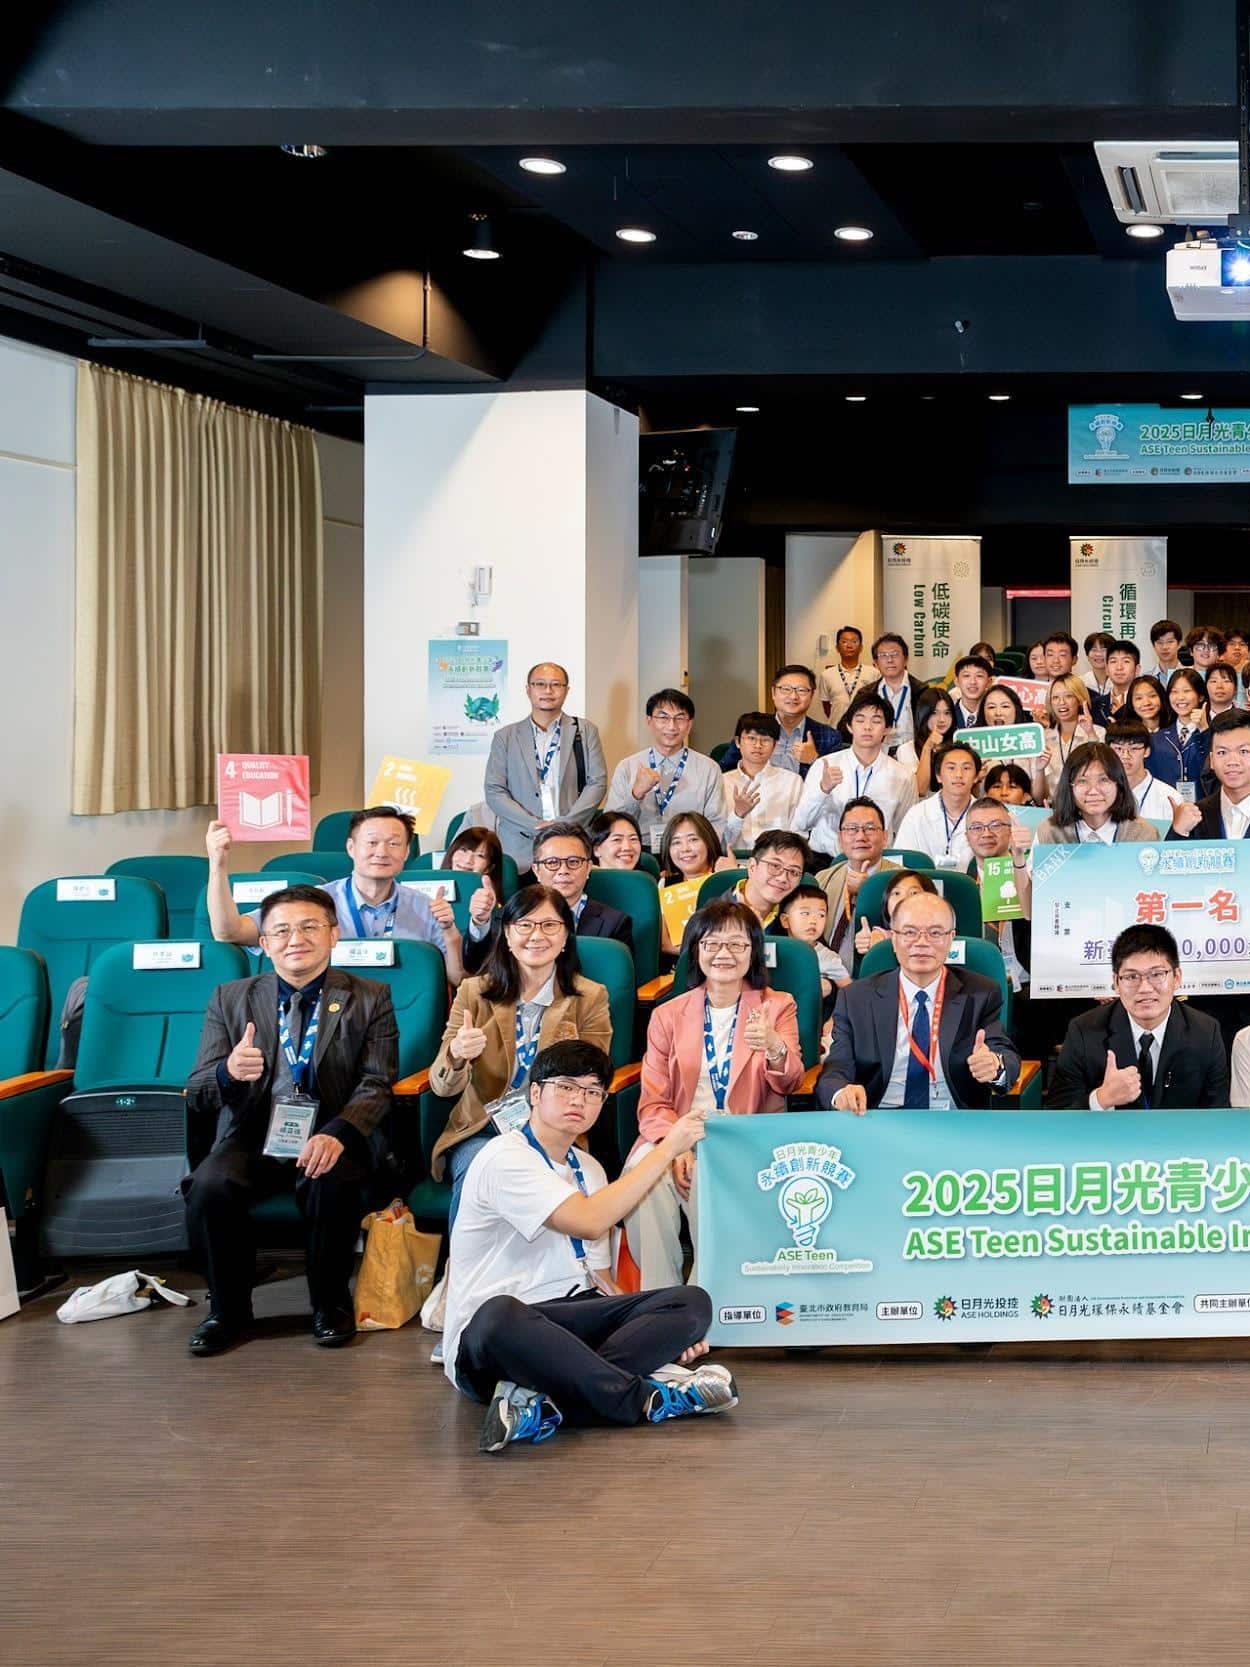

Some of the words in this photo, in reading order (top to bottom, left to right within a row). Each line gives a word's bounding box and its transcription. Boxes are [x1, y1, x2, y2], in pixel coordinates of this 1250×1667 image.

[1141, 444, 1161, 454] ASE
[1163, 444, 1187, 454] Teen
[1190, 443, 1250, 454] Sustainable
[913, 585, 926, 606] Low
[1119, 583, 1136, 639] 循環再
[931, 582, 950, 659] 低碳使命
[913, 611, 926, 657] Carbon
[225, 761, 236, 779] 4
[242, 771, 279, 780] EDUCATION
[988, 862, 1001, 876] 15
[1036, 845, 1071, 881] BANK
[1135, 890, 1238, 924] 第一名
[777, 1145, 838, 1160] 日月光青少年
[760, 1156, 850, 1188] 永續創新競賽
[906, 1230, 961, 1256] ASE
[969, 1229, 1039, 1254] Teen
[1047, 1222, 1223, 1253] Sustainable
[778, 1251, 802, 1261] ASE
[805, 1251, 834, 1261] Teen
[799, 1303, 868, 1314] 臺北市政府教育局
[881, 1306, 918, 1317] 主辦單位
[961, 1298, 1019, 1310] 日月光投控
[1059, 1301, 1184, 1317] 日月光環保永續基金會
[723, 1310, 761, 1321] 指導單位
[961, 1311, 976, 1319] ASE
[977, 1310, 1019, 1319] HOLDINGS
